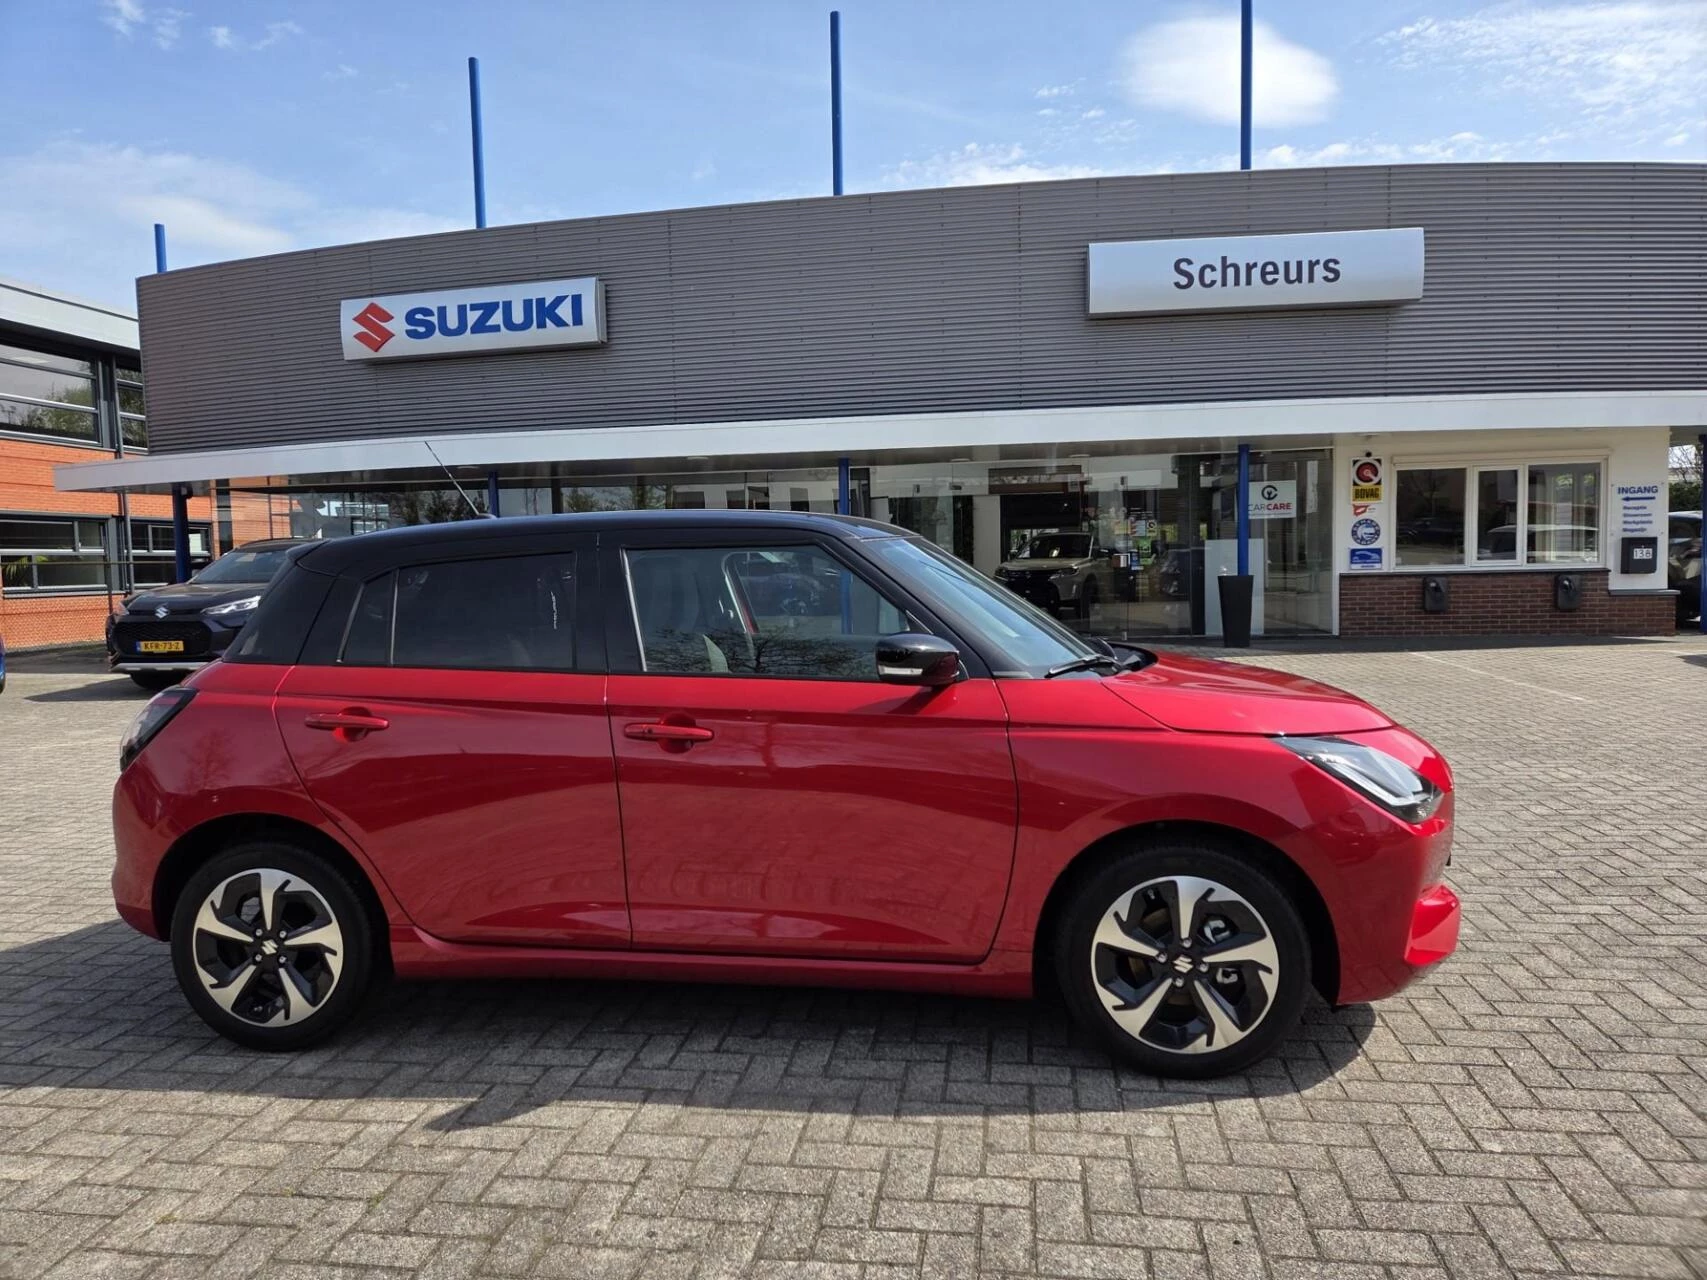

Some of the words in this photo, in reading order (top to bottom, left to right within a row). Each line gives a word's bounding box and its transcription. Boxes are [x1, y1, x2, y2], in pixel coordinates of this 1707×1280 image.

[1173, 256, 1341, 290] Schreurs
[404, 293, 584, 340] SUZUKI
[1354, 487, 1380, 499] BOVAG
[1617, 485, 1659, 494] INGANG
